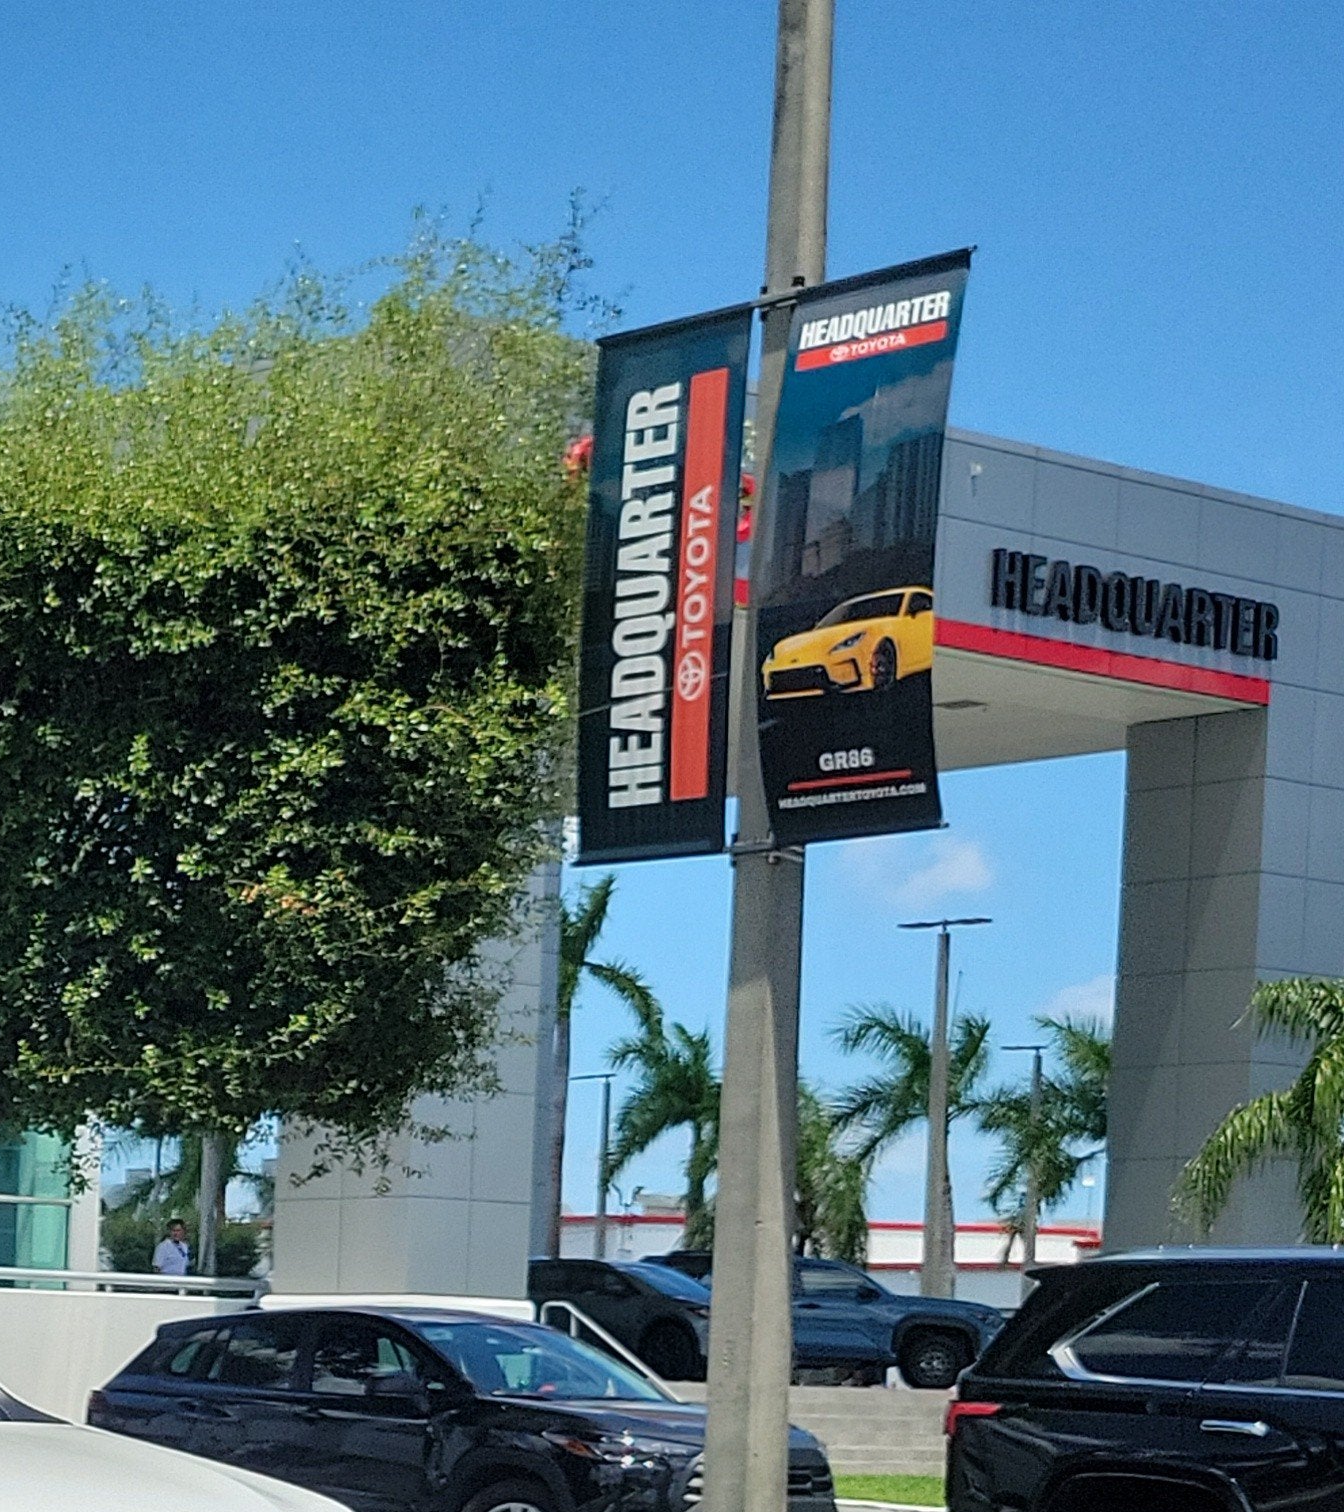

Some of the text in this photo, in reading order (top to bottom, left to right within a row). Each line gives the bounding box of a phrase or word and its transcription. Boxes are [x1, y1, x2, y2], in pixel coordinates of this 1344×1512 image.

[798, 290, 951, 350] HEADQUARTER
[850, 334, 906, 355] TOYOTA
[608, 381, 681, 809] HEADQUARTER
[682, 484, 714, 650] TOYOTA
[990, 547, 1280, 661] HEADQUARTER
[819, 748, 874, 771] GR86
